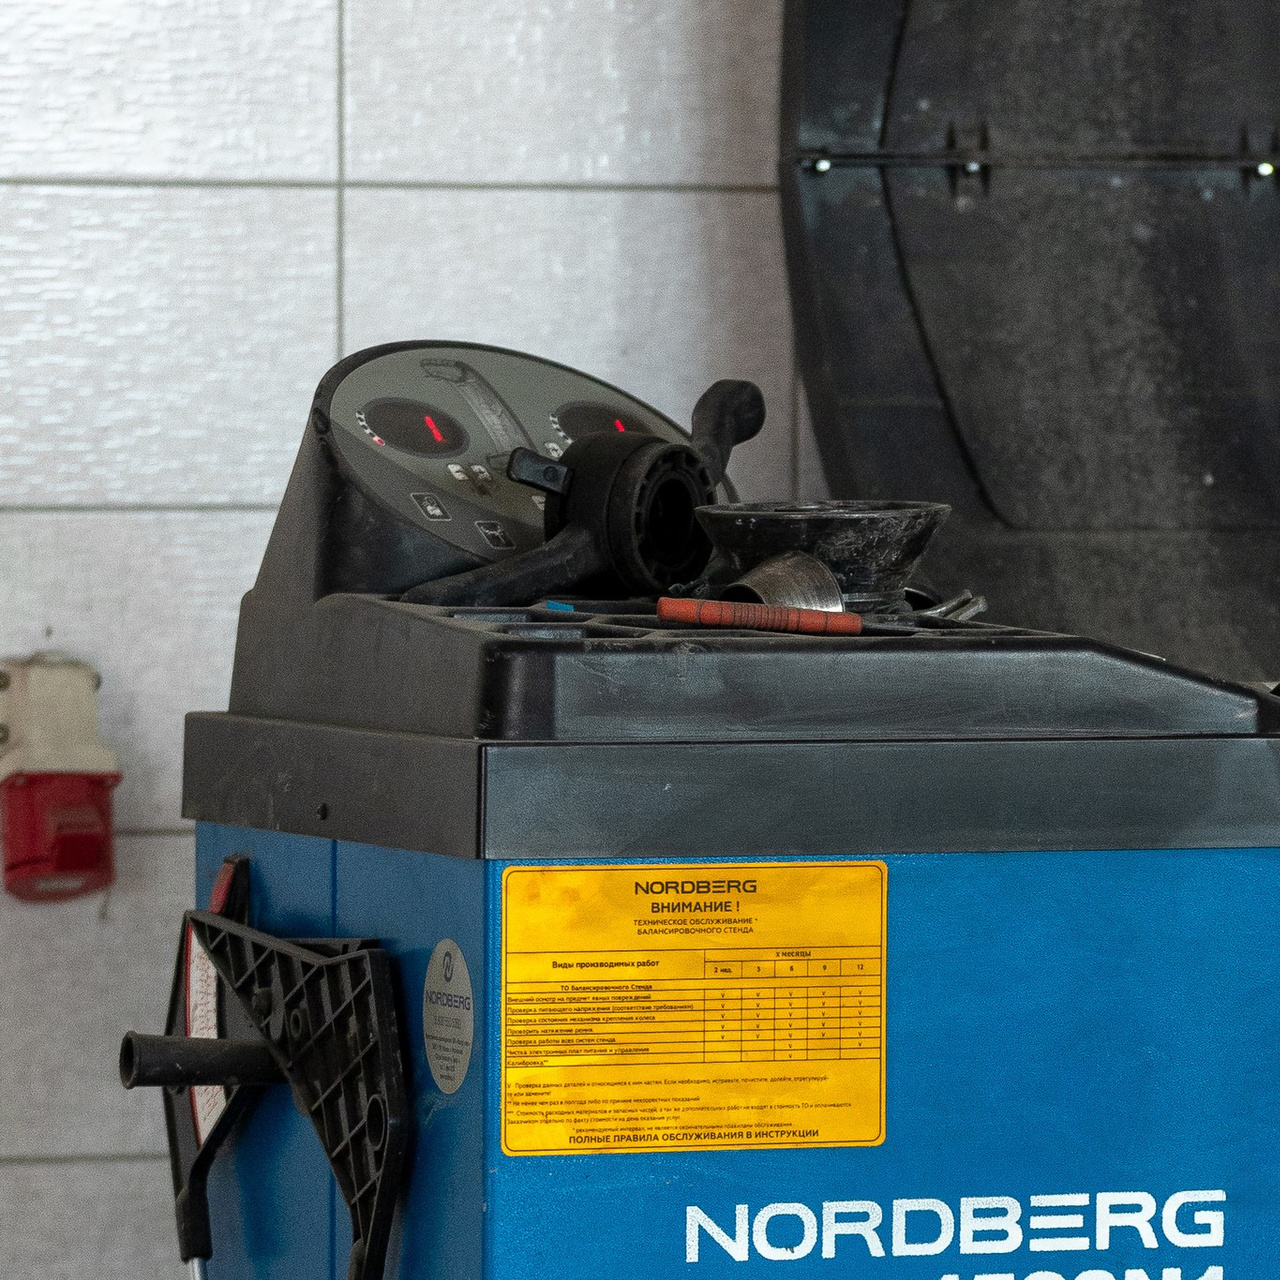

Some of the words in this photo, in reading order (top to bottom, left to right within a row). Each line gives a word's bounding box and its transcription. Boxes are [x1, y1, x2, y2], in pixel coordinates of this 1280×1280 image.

[634, 880, 757, 895] NORDBERG
[651, 901, 732, 913] ВНИМАНИЕ
[633, 918, 688, 926] ТЕХНИЧЕСКОЕ
[689, 917, 753, 926] ОБСЛУЖИВАНИЕ
[637, 927, 722, 935] БАЛАНСИРОВОЧНОГО
[723, 926, 754, 934] СТЕНДА
[552, 961, 574, 969] Виды
[576, 960, 635, 969] производимых
[636, 959, 660, 969] работ
[425, 989, 471, 1011] NORDBERG
[568, 1135, 611, 1144] ПОЛНЫЕ
[613, 1133, 659, 1142] ПРАВИЛА
[661, 1131, 744, 1141] ОБСЛУЖИВАНИЯ
[746, 1131, 752, 1139] В
[754, 1129, 819, 1139] ИНСТРУКЦИИ
[685, 1190, 1227, 1263] NORDBERG
